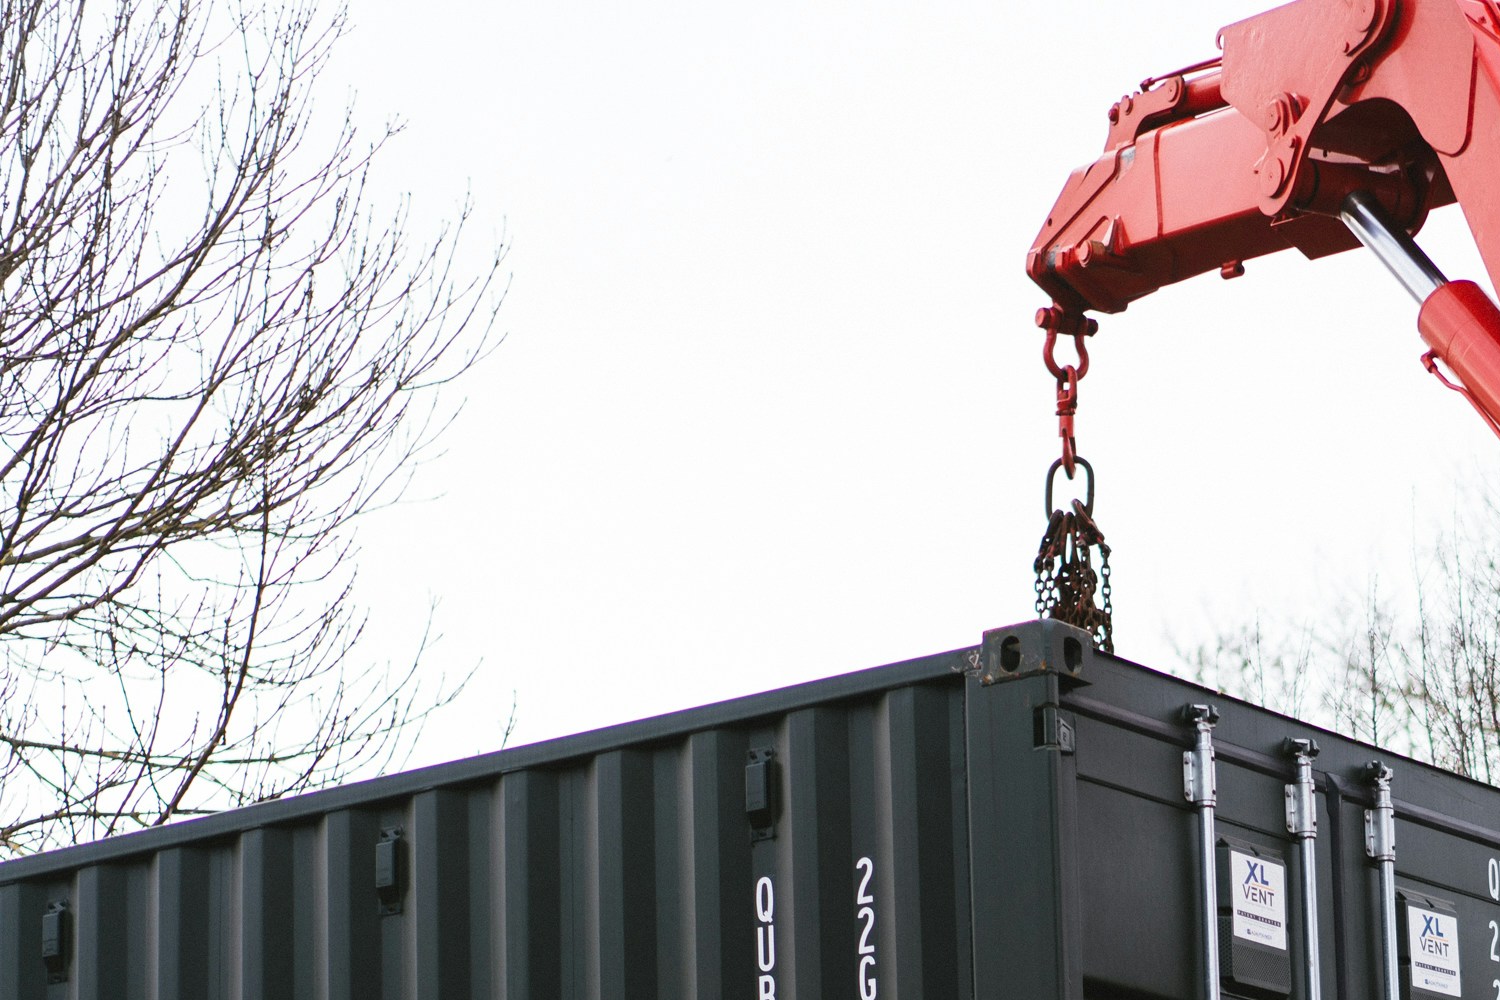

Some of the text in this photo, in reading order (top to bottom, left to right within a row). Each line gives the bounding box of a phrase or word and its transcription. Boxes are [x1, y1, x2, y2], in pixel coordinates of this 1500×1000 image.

[1244, 860, 1269, 886] XL
[1242, 884, 1274, 907] VENT
[1421, 914, 1444, 938] XL
[1420, 936, 1449, 958] VENT
